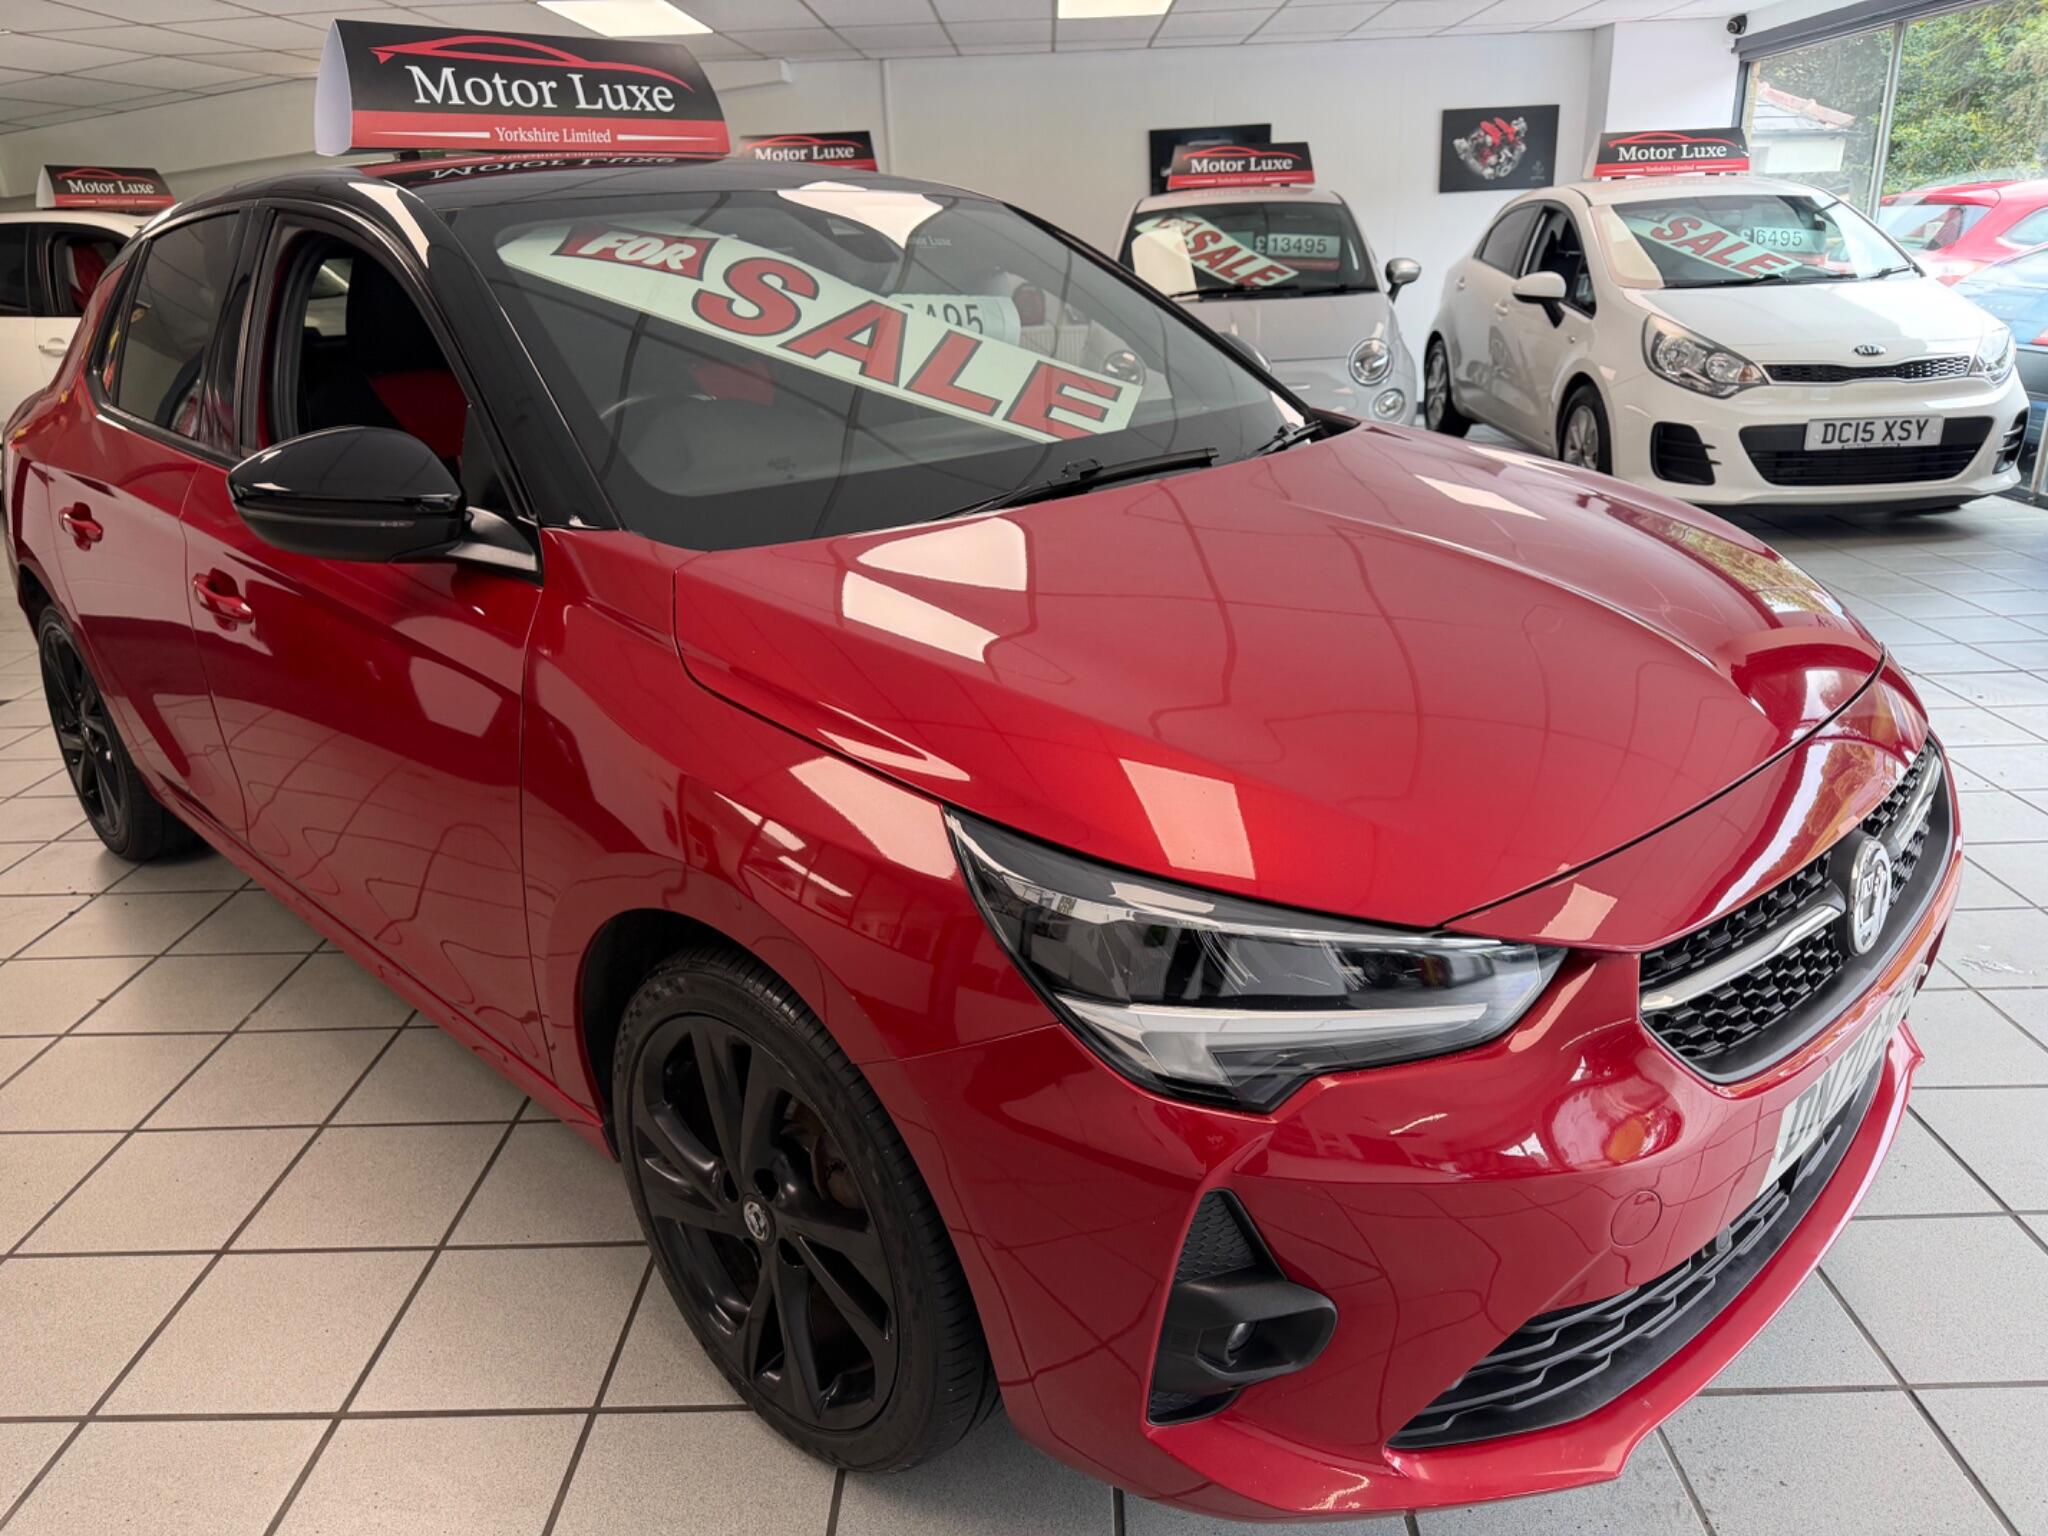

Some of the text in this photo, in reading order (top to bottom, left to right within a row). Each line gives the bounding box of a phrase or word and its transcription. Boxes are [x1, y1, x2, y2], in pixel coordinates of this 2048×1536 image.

[405, 65, 675, 113] Motor Luxe
[494, 127, 611, 143] Yorkshire Limited
[753, 145, 855, 161] Motor Luxe
[1617, 144, 1728, 162] Motor Luxe
[1190, 157, 1293, 174] Motor Luxe
[67, 179, 155, 195] Motor Luxe
[577, 229, 700, 272] FOR
[1254, 236, 1327, 254] £13495
[1651, 217, 1790, 277] SALE
[1188, 230, 1291, 287] SALE
[692, 256, 1123, 440] SALE
[1821, 418, 1929, 444] DC15 XSY
